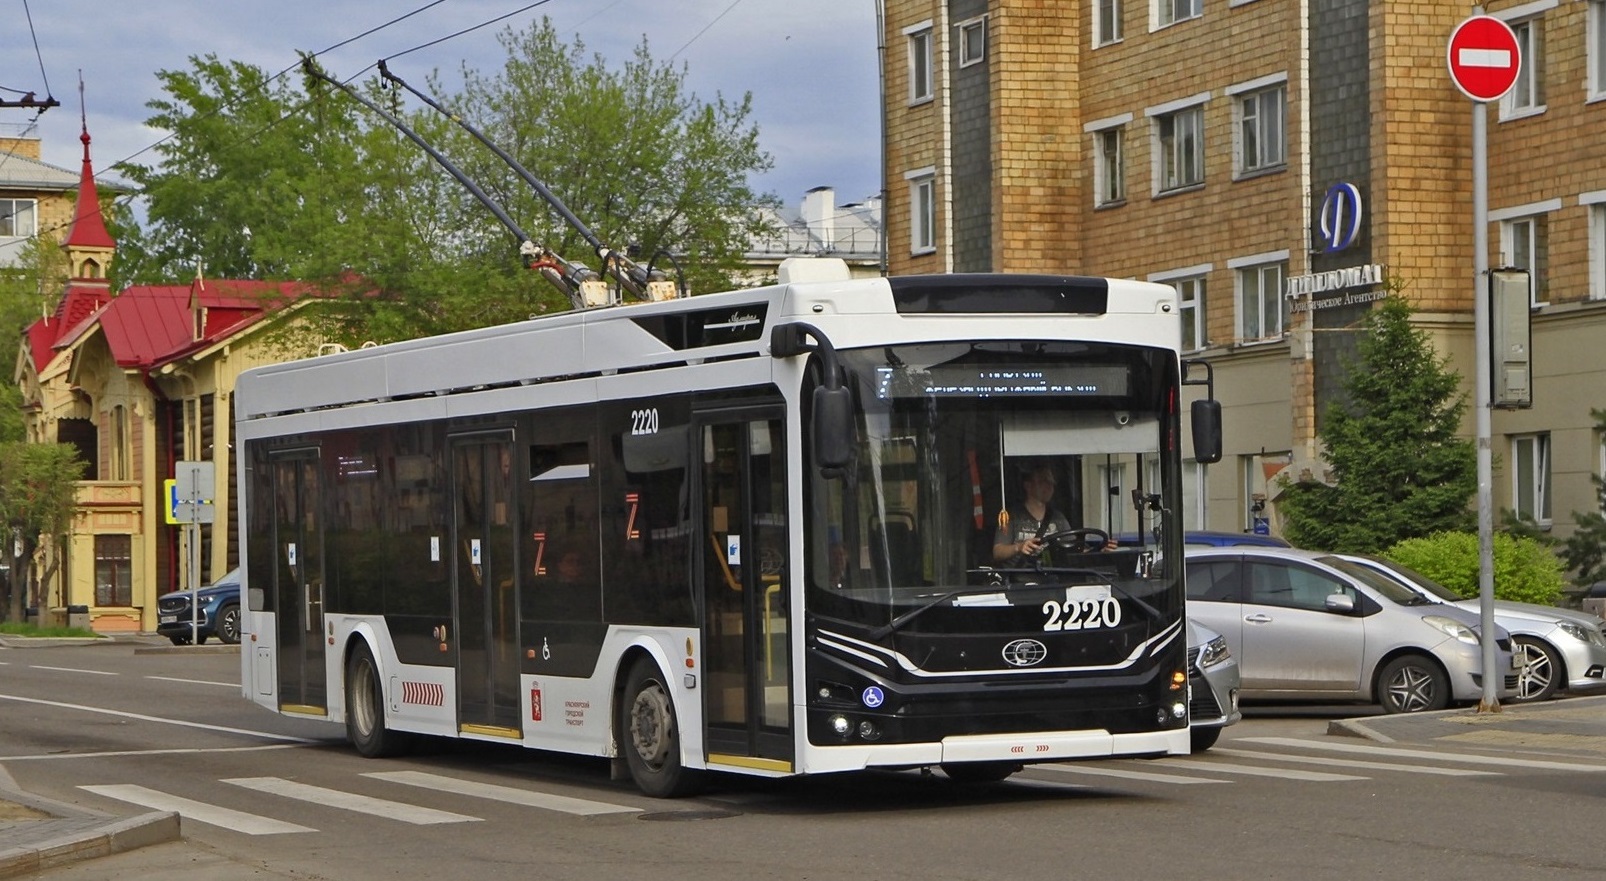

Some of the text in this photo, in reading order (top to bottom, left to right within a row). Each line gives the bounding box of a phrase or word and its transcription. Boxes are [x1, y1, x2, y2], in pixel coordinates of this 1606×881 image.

[1344, 290, 1388, 306] Агентство
[631, 408, 659, 436] 2220
[1042, 597, 1122, 631] 2220
